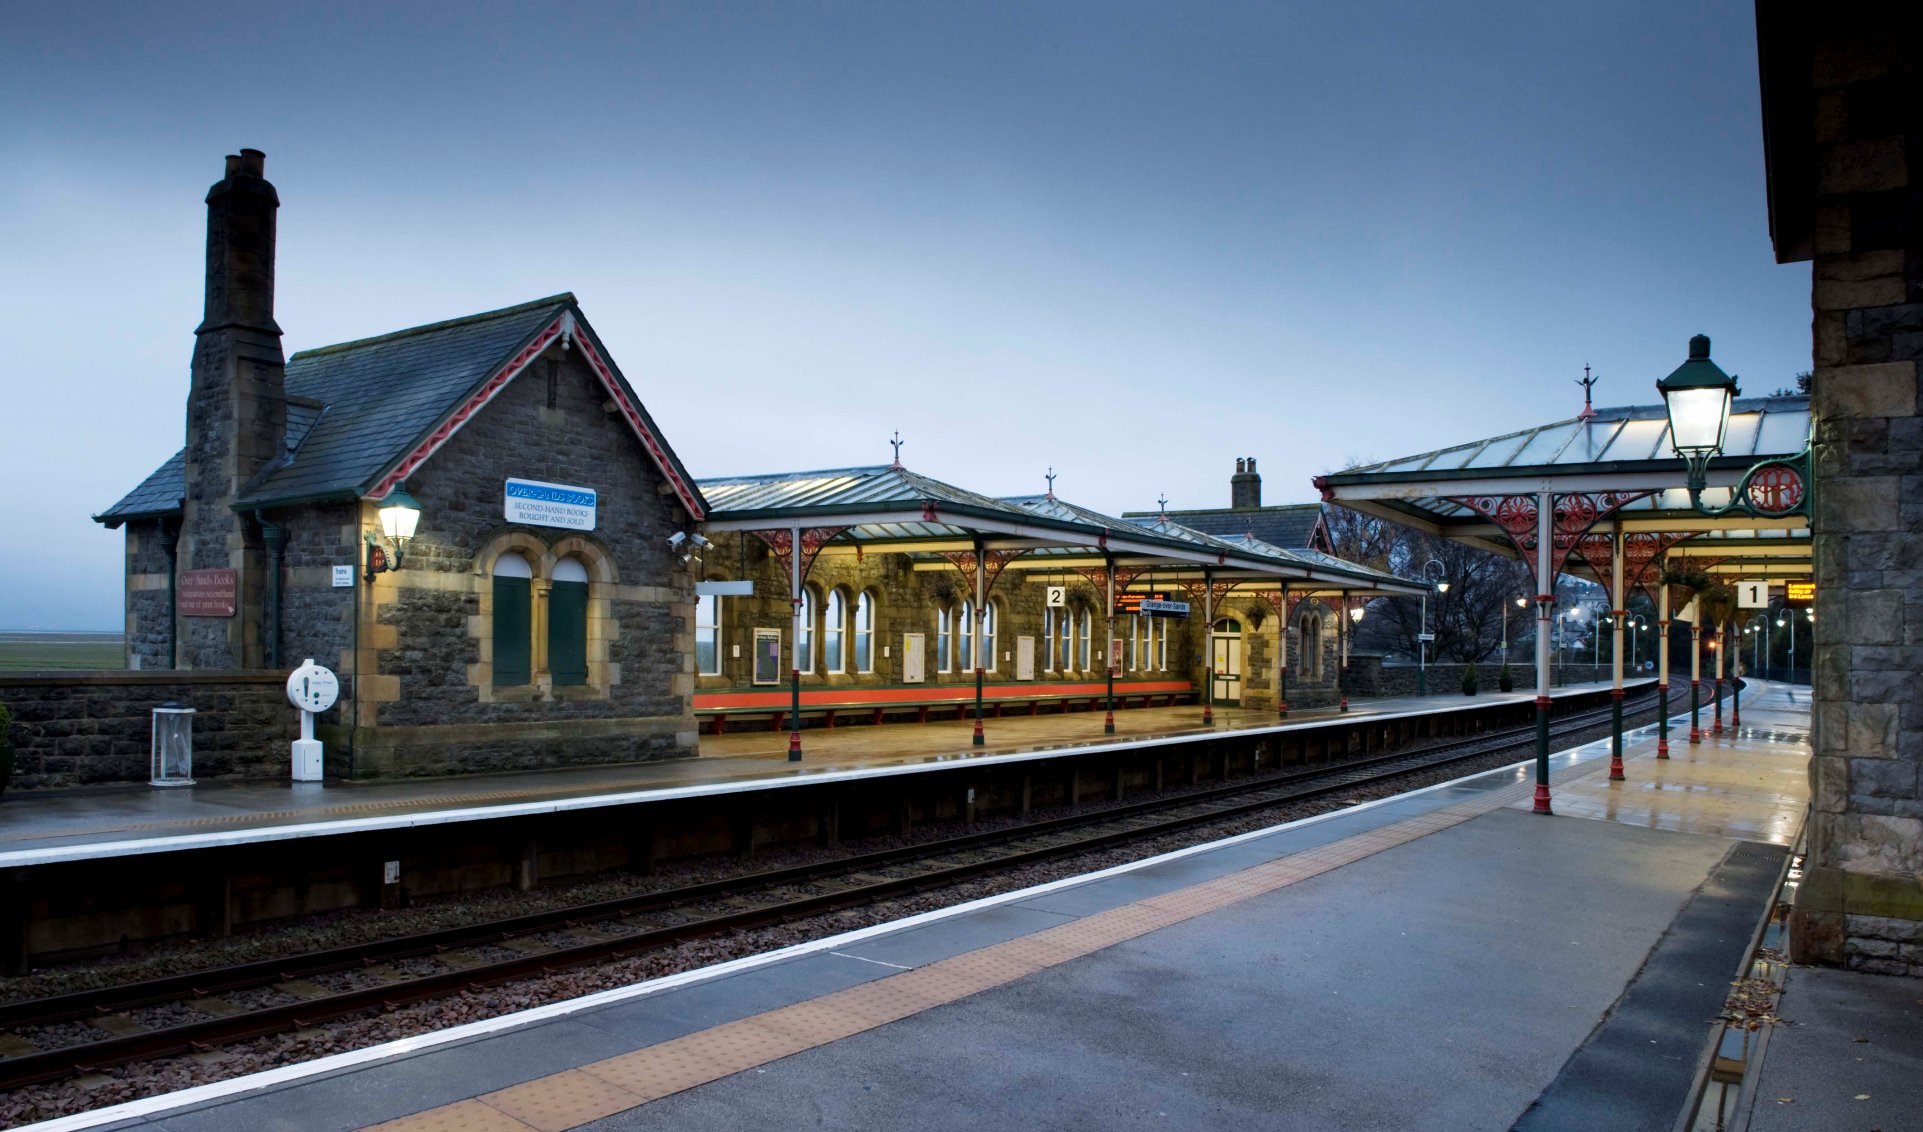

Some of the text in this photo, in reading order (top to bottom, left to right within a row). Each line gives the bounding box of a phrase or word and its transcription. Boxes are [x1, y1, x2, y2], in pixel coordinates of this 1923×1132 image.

[513, 501, 589, 517] SECOND-HAND BOOKS
[519, 512, 585, 526] BOUGHT AND SOLD
[214, 573, 234, 585] Books
[1052, 589, 1061, 603] 2
[1749, 585, 1757, 603] 1
[1146, 600, 1186, 610] Grange-over-Sands
